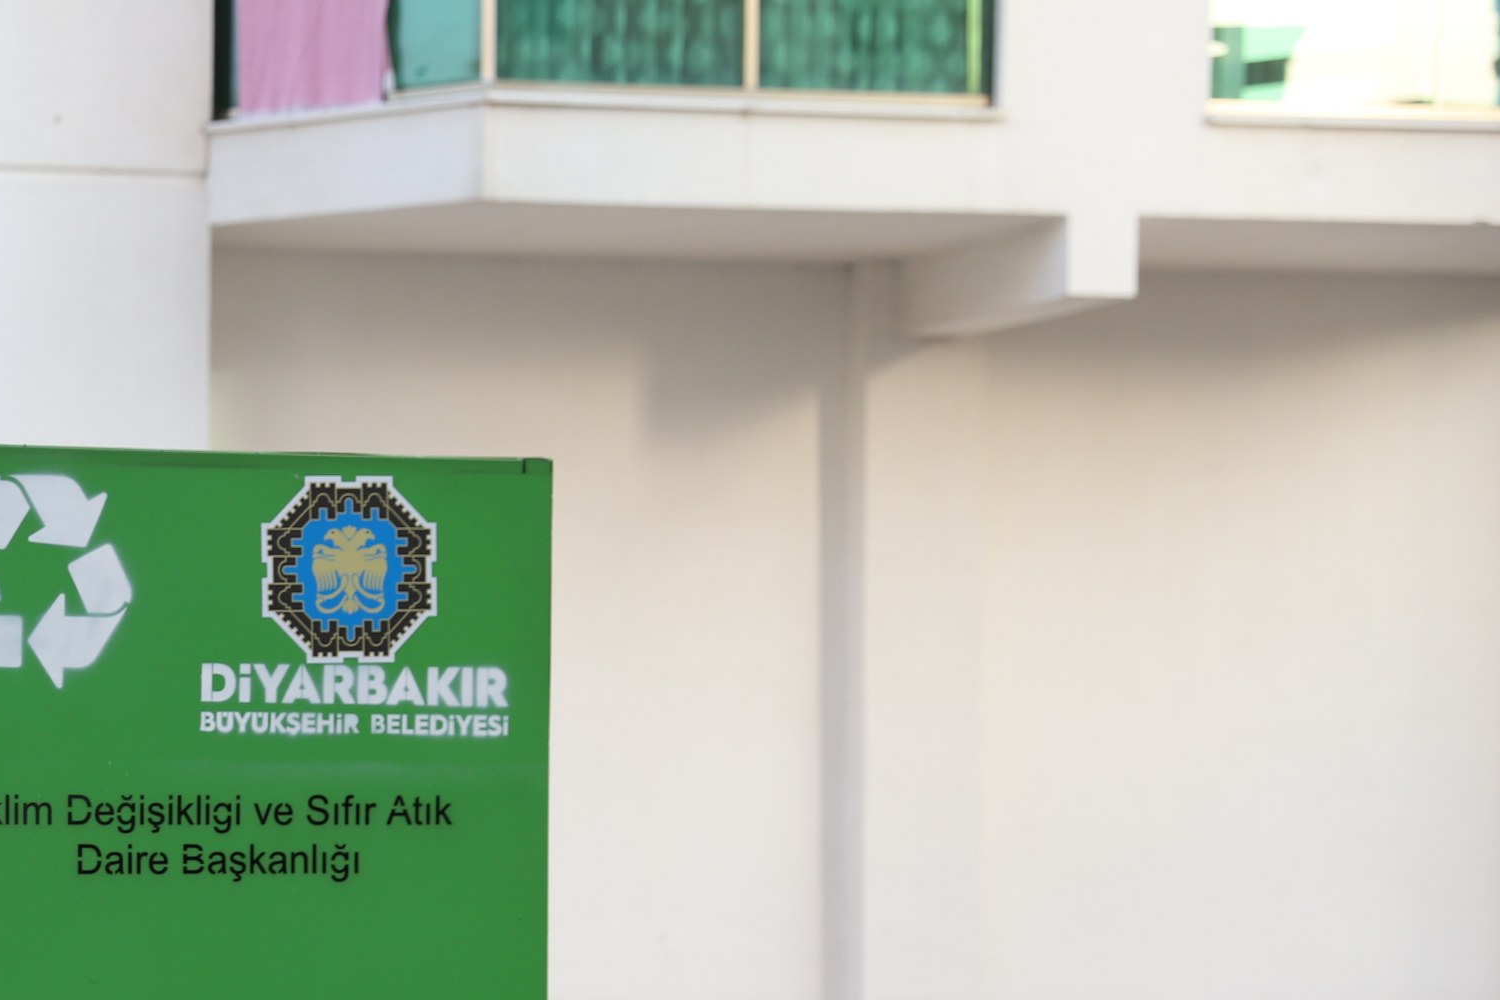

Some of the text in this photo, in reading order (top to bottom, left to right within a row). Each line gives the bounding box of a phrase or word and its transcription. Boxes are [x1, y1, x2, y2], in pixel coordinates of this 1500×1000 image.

[254, 802, 293, 825] ve
[307, 795, 377, 826] Sıfır
[386, 795, 453, 825] Atık
[77, 844, 359, 882] Daire Başkanlığı
